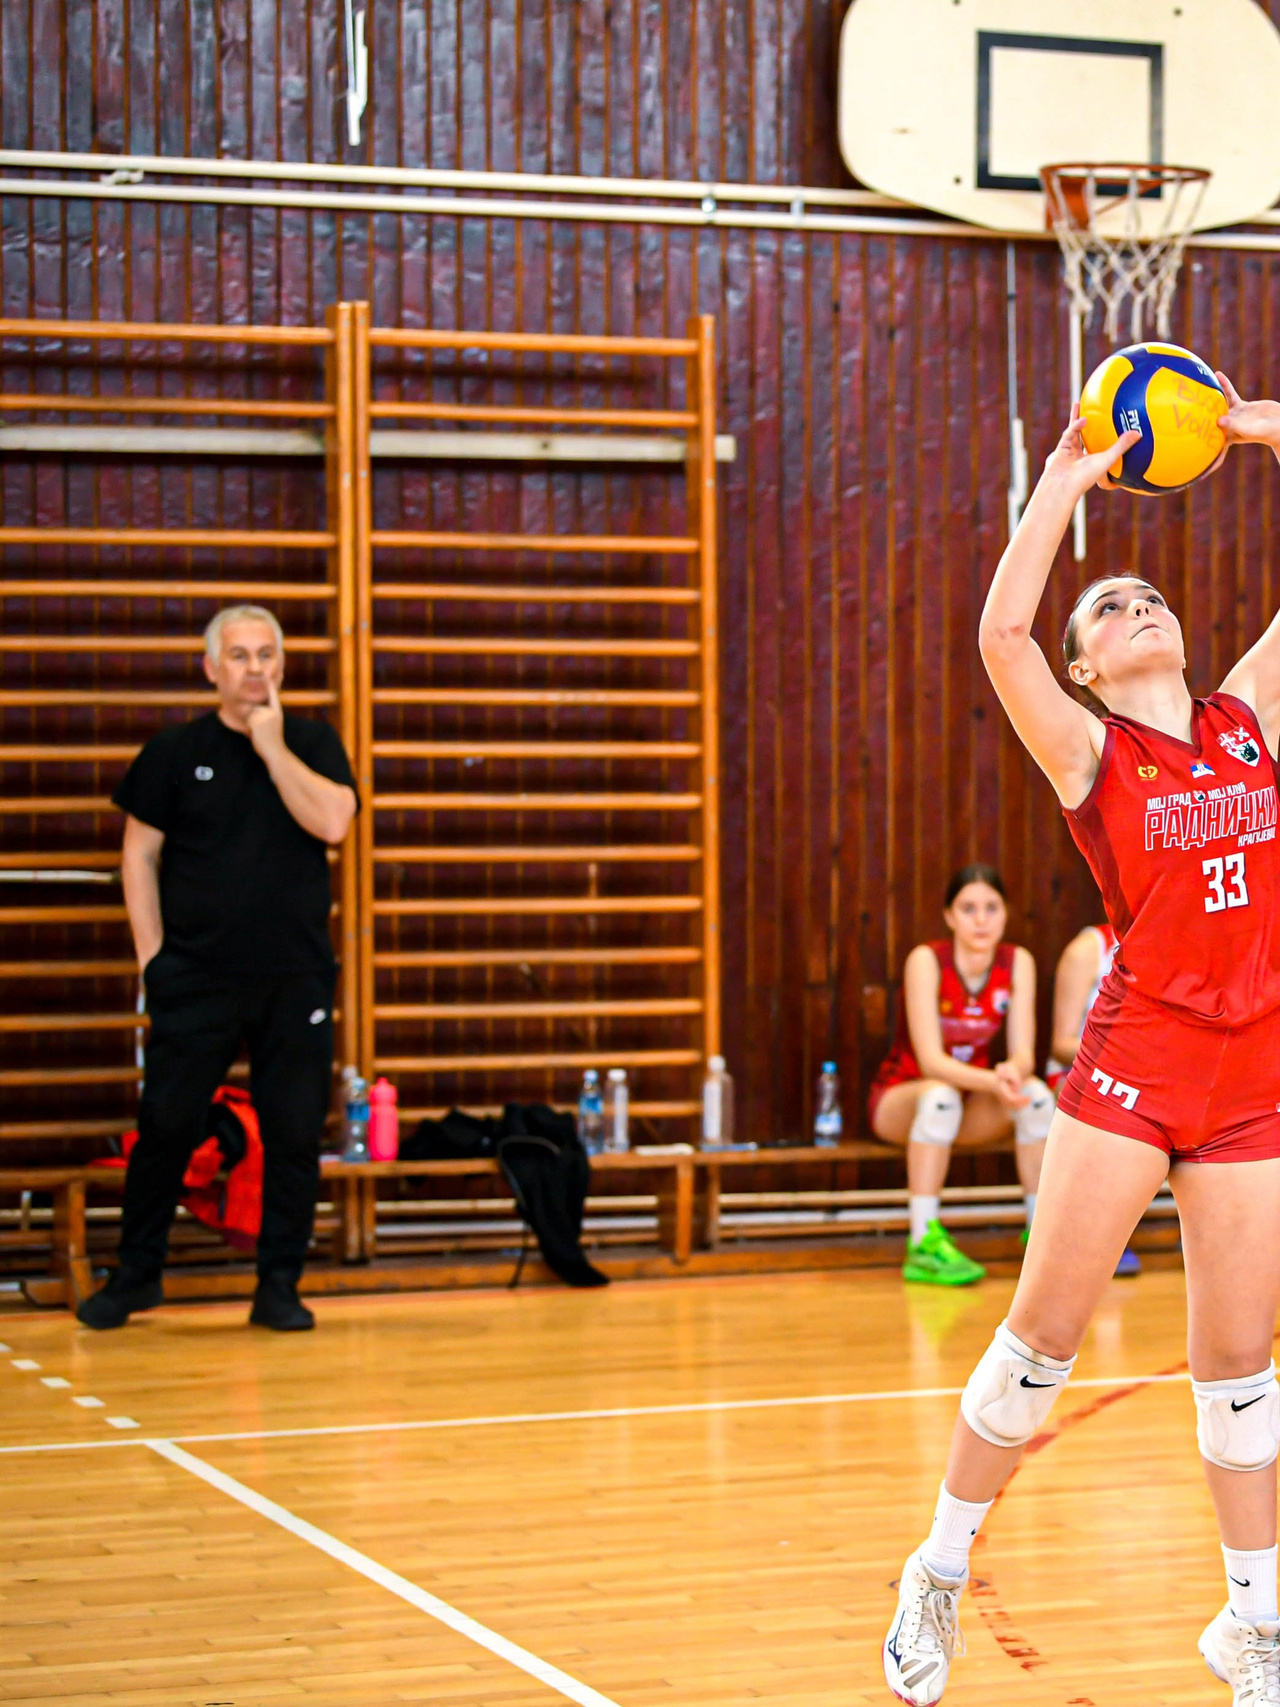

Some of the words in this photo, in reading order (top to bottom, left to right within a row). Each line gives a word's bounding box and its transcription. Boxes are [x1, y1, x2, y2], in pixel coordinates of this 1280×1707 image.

[1147, 796, 1166, 811] МОЈ
[1168, 792, 1192, 807] ГРАД
[1207, 786, 1227, 801] МОЈ
[1226, 781, 1247, 797] КЛУБ
[1145, 785, 1278, 851] РАДНИЧКИ
[1201, 852, 1249, 913] 33
